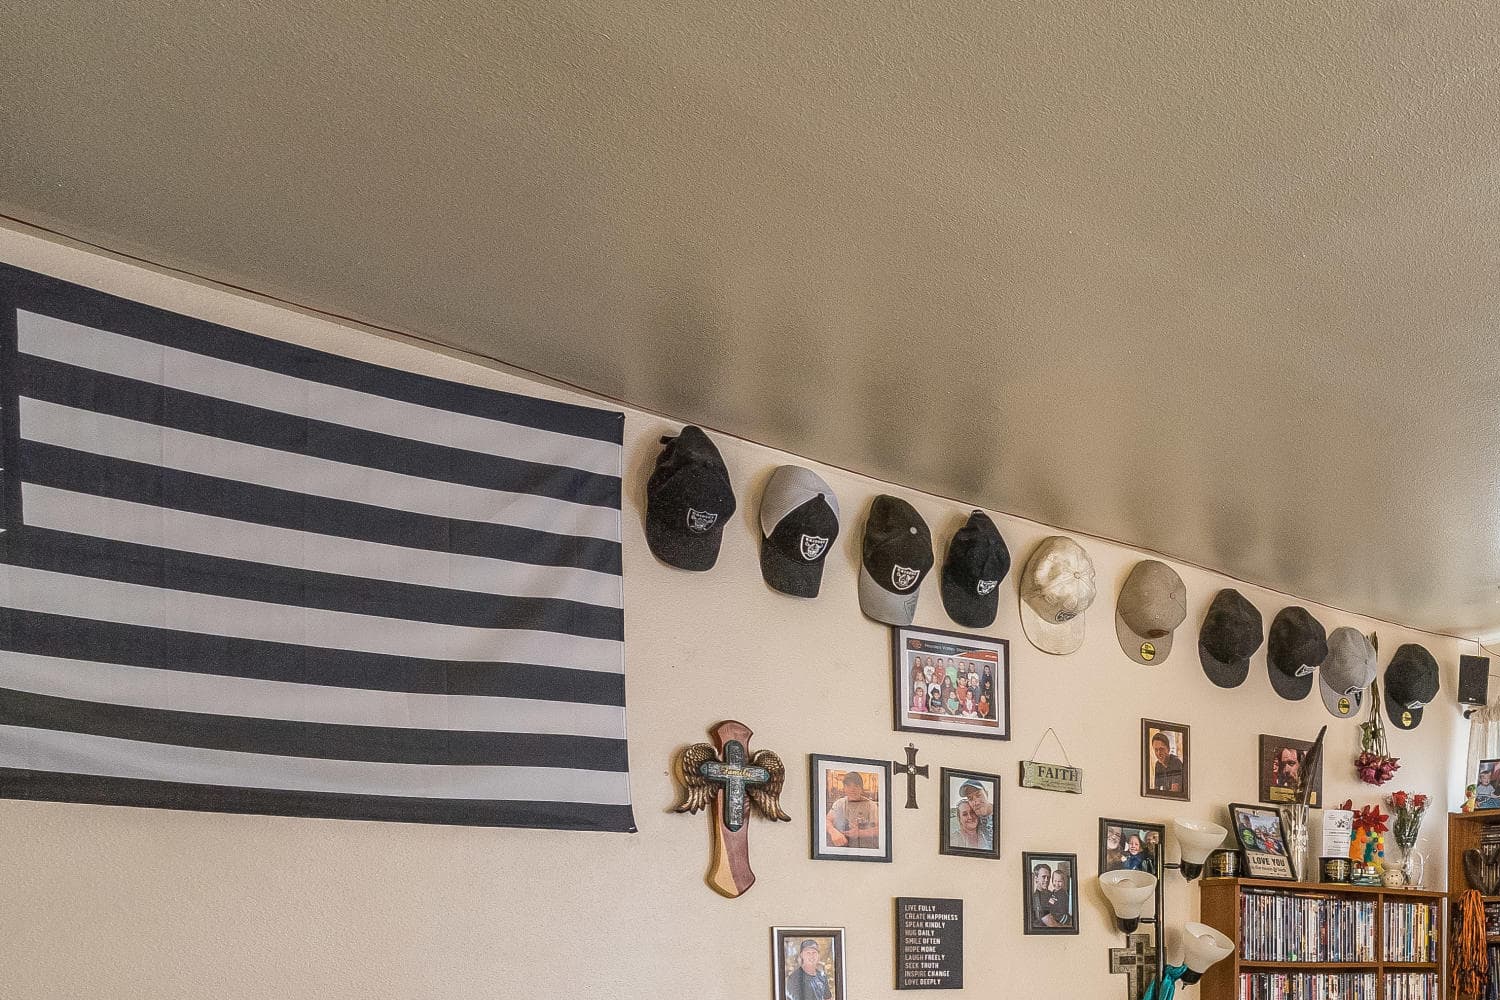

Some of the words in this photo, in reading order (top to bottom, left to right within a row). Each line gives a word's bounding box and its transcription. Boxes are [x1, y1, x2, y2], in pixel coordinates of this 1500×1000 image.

[1037, 765, 1079, 782] FAITH
[1252, 857, 1271, 866] LOVE
[1271, 857, 1285, 866] YOU
